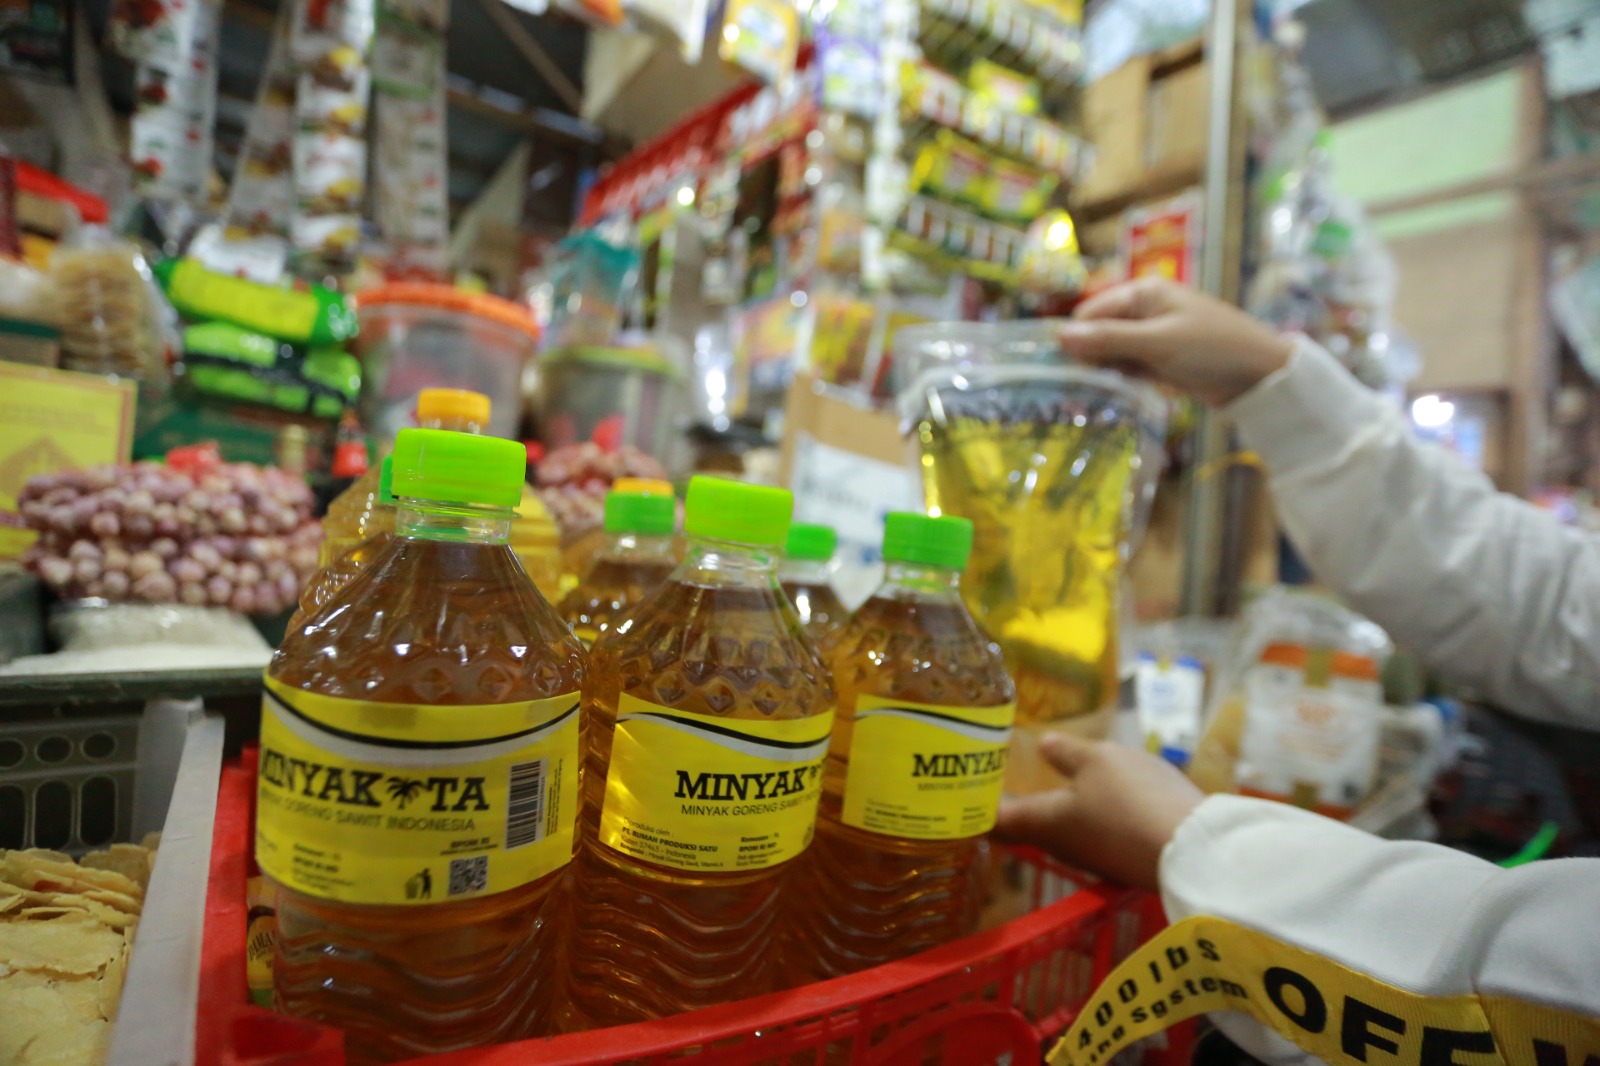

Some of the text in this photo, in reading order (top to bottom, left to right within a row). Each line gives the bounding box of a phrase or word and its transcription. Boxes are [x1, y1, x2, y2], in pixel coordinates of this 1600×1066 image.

[674, 766, 808, 801] MINYAK
[681, 804, 729, 816] MINYAK
[732, 802, 777, 816] GORENG
[386, 814, 476, 832] INDONESIA
[632, 830, 658, 843] RUMAH
[659, 838, 697, 851] PRODUKSI
